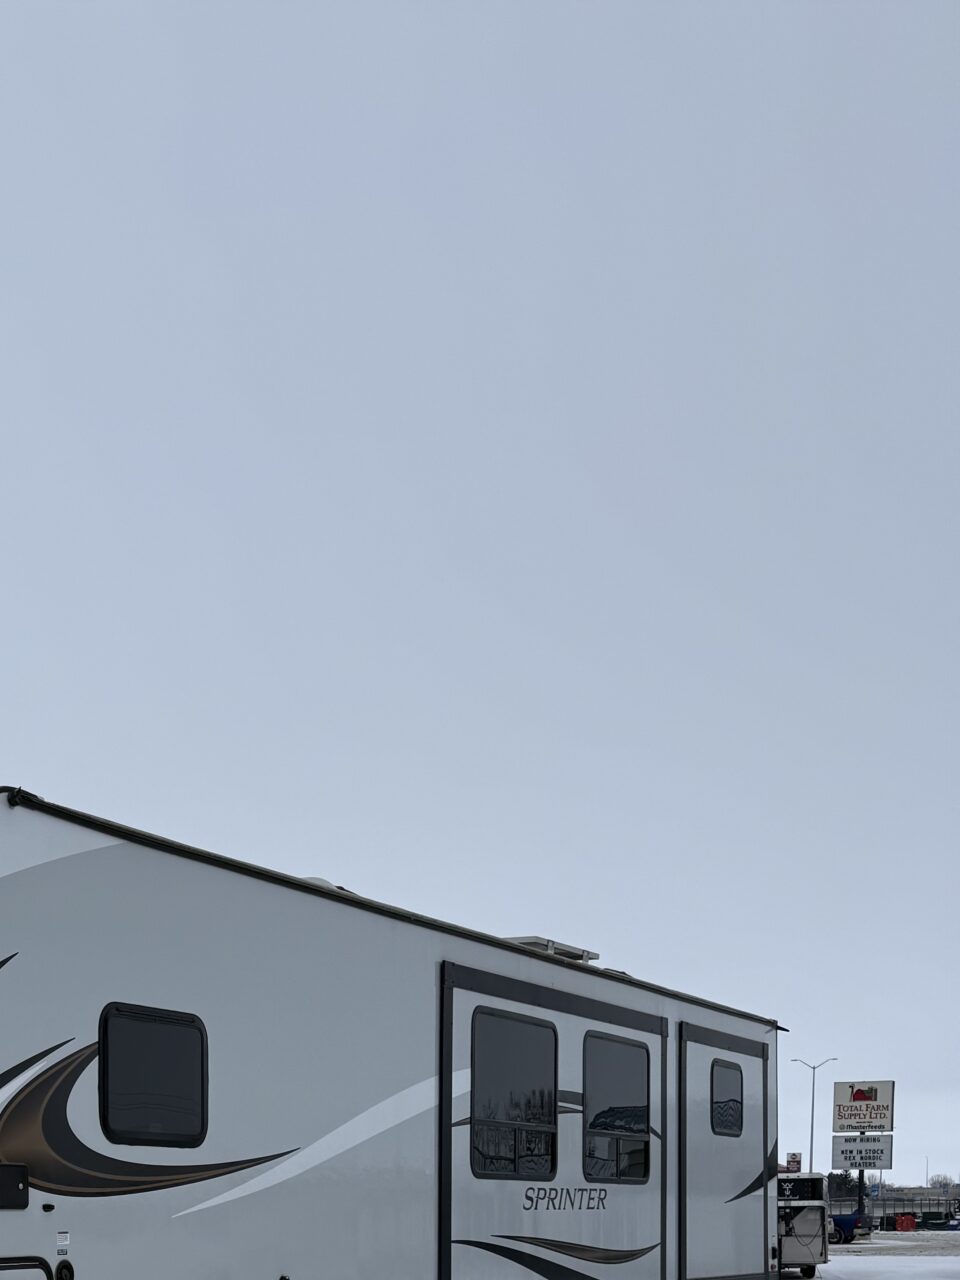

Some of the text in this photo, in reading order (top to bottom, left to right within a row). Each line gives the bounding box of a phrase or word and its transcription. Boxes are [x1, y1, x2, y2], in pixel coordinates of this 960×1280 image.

[836, 1103, 890, 1112] TOTAL FARM
[837, 1111, 867, 1120] SUPPLY
[522, 1186, 608, 1211] SPRINTER
